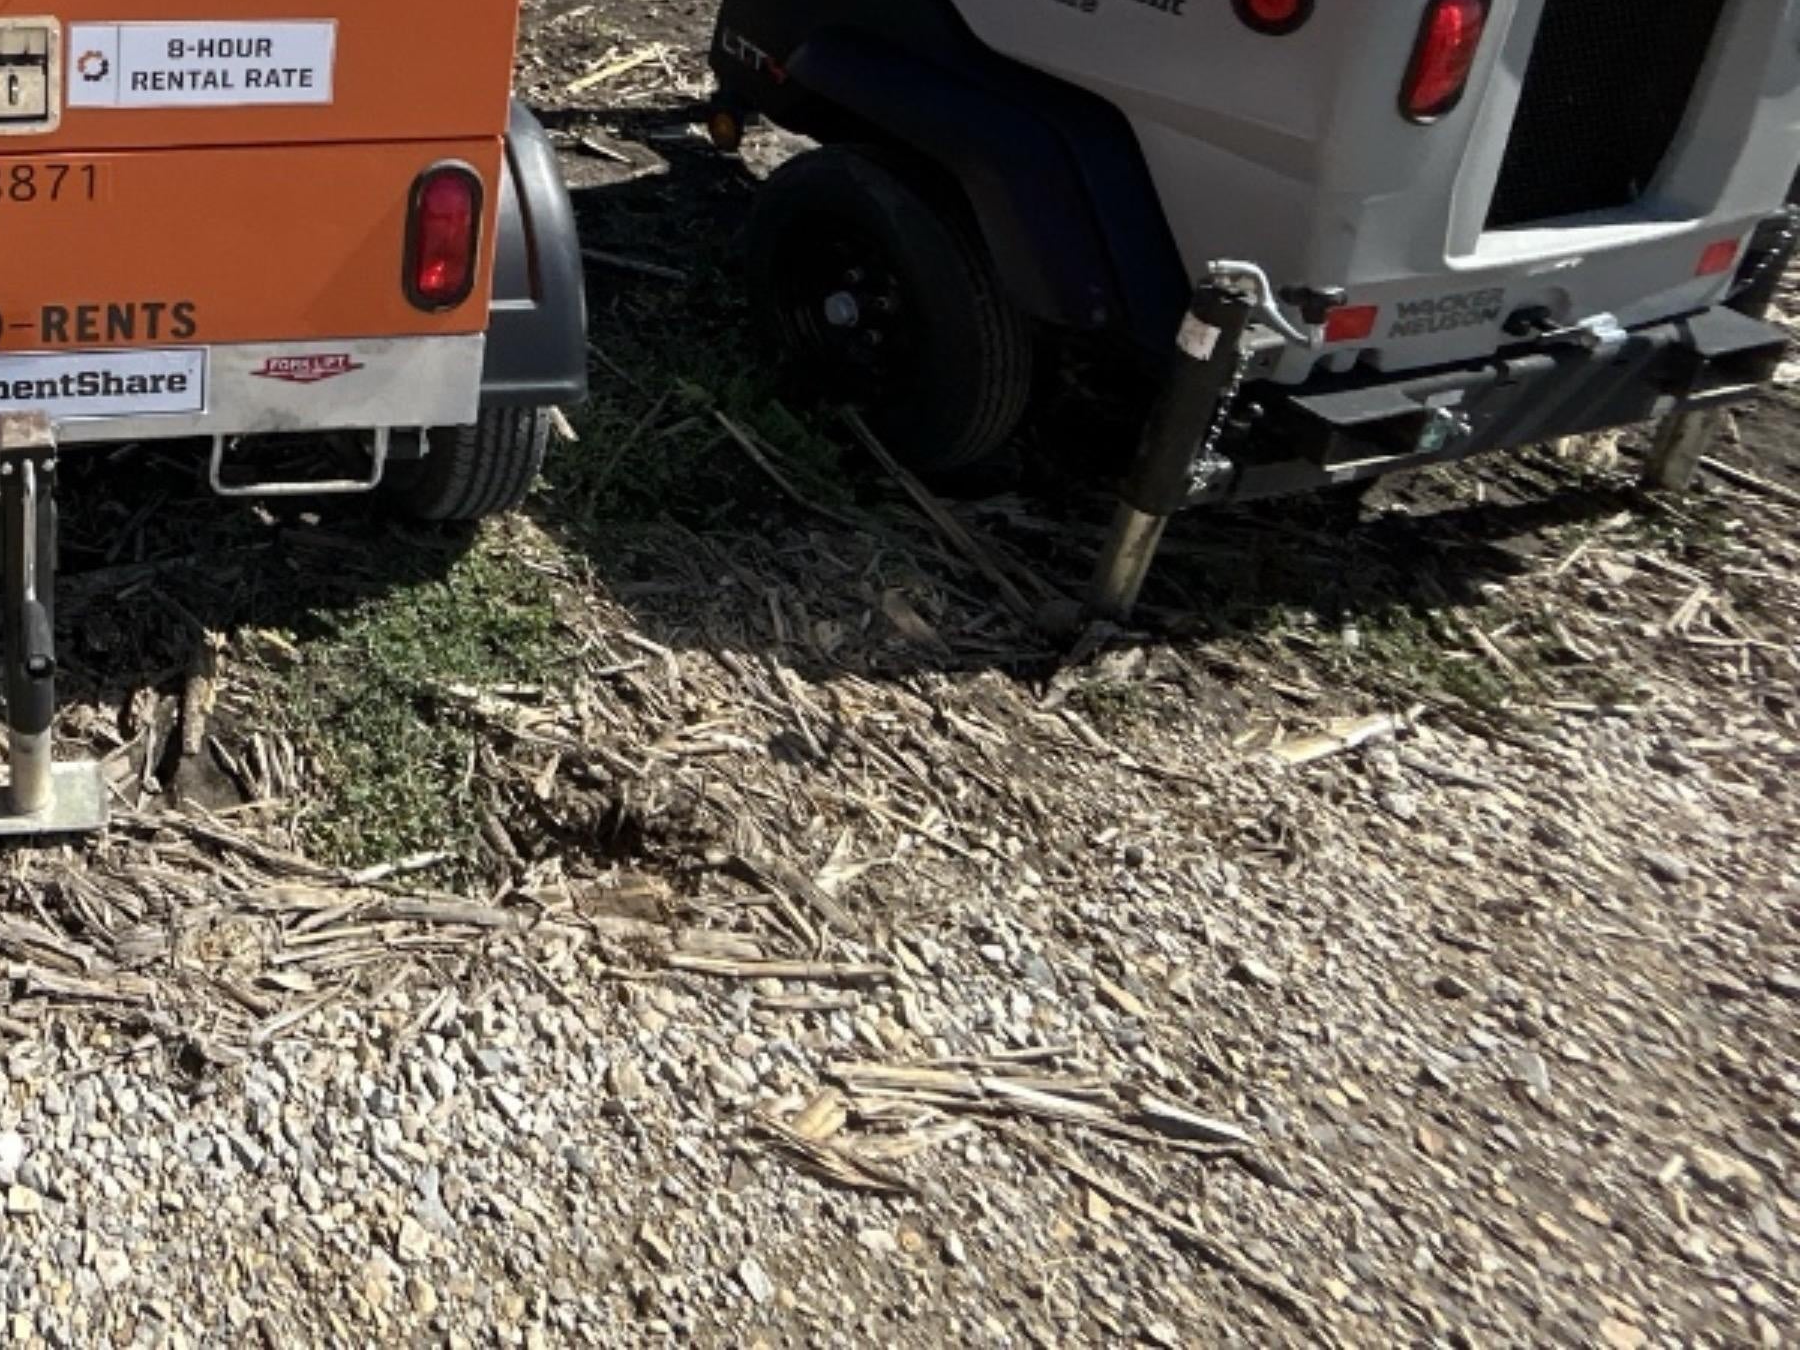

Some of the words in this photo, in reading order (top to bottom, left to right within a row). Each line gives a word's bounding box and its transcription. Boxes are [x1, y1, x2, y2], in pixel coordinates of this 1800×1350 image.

[167, 38, 273, 58] 8-HOUR
[131, 69, 234, 91] RENTAL
[245, 68, 313, 88] RATE
